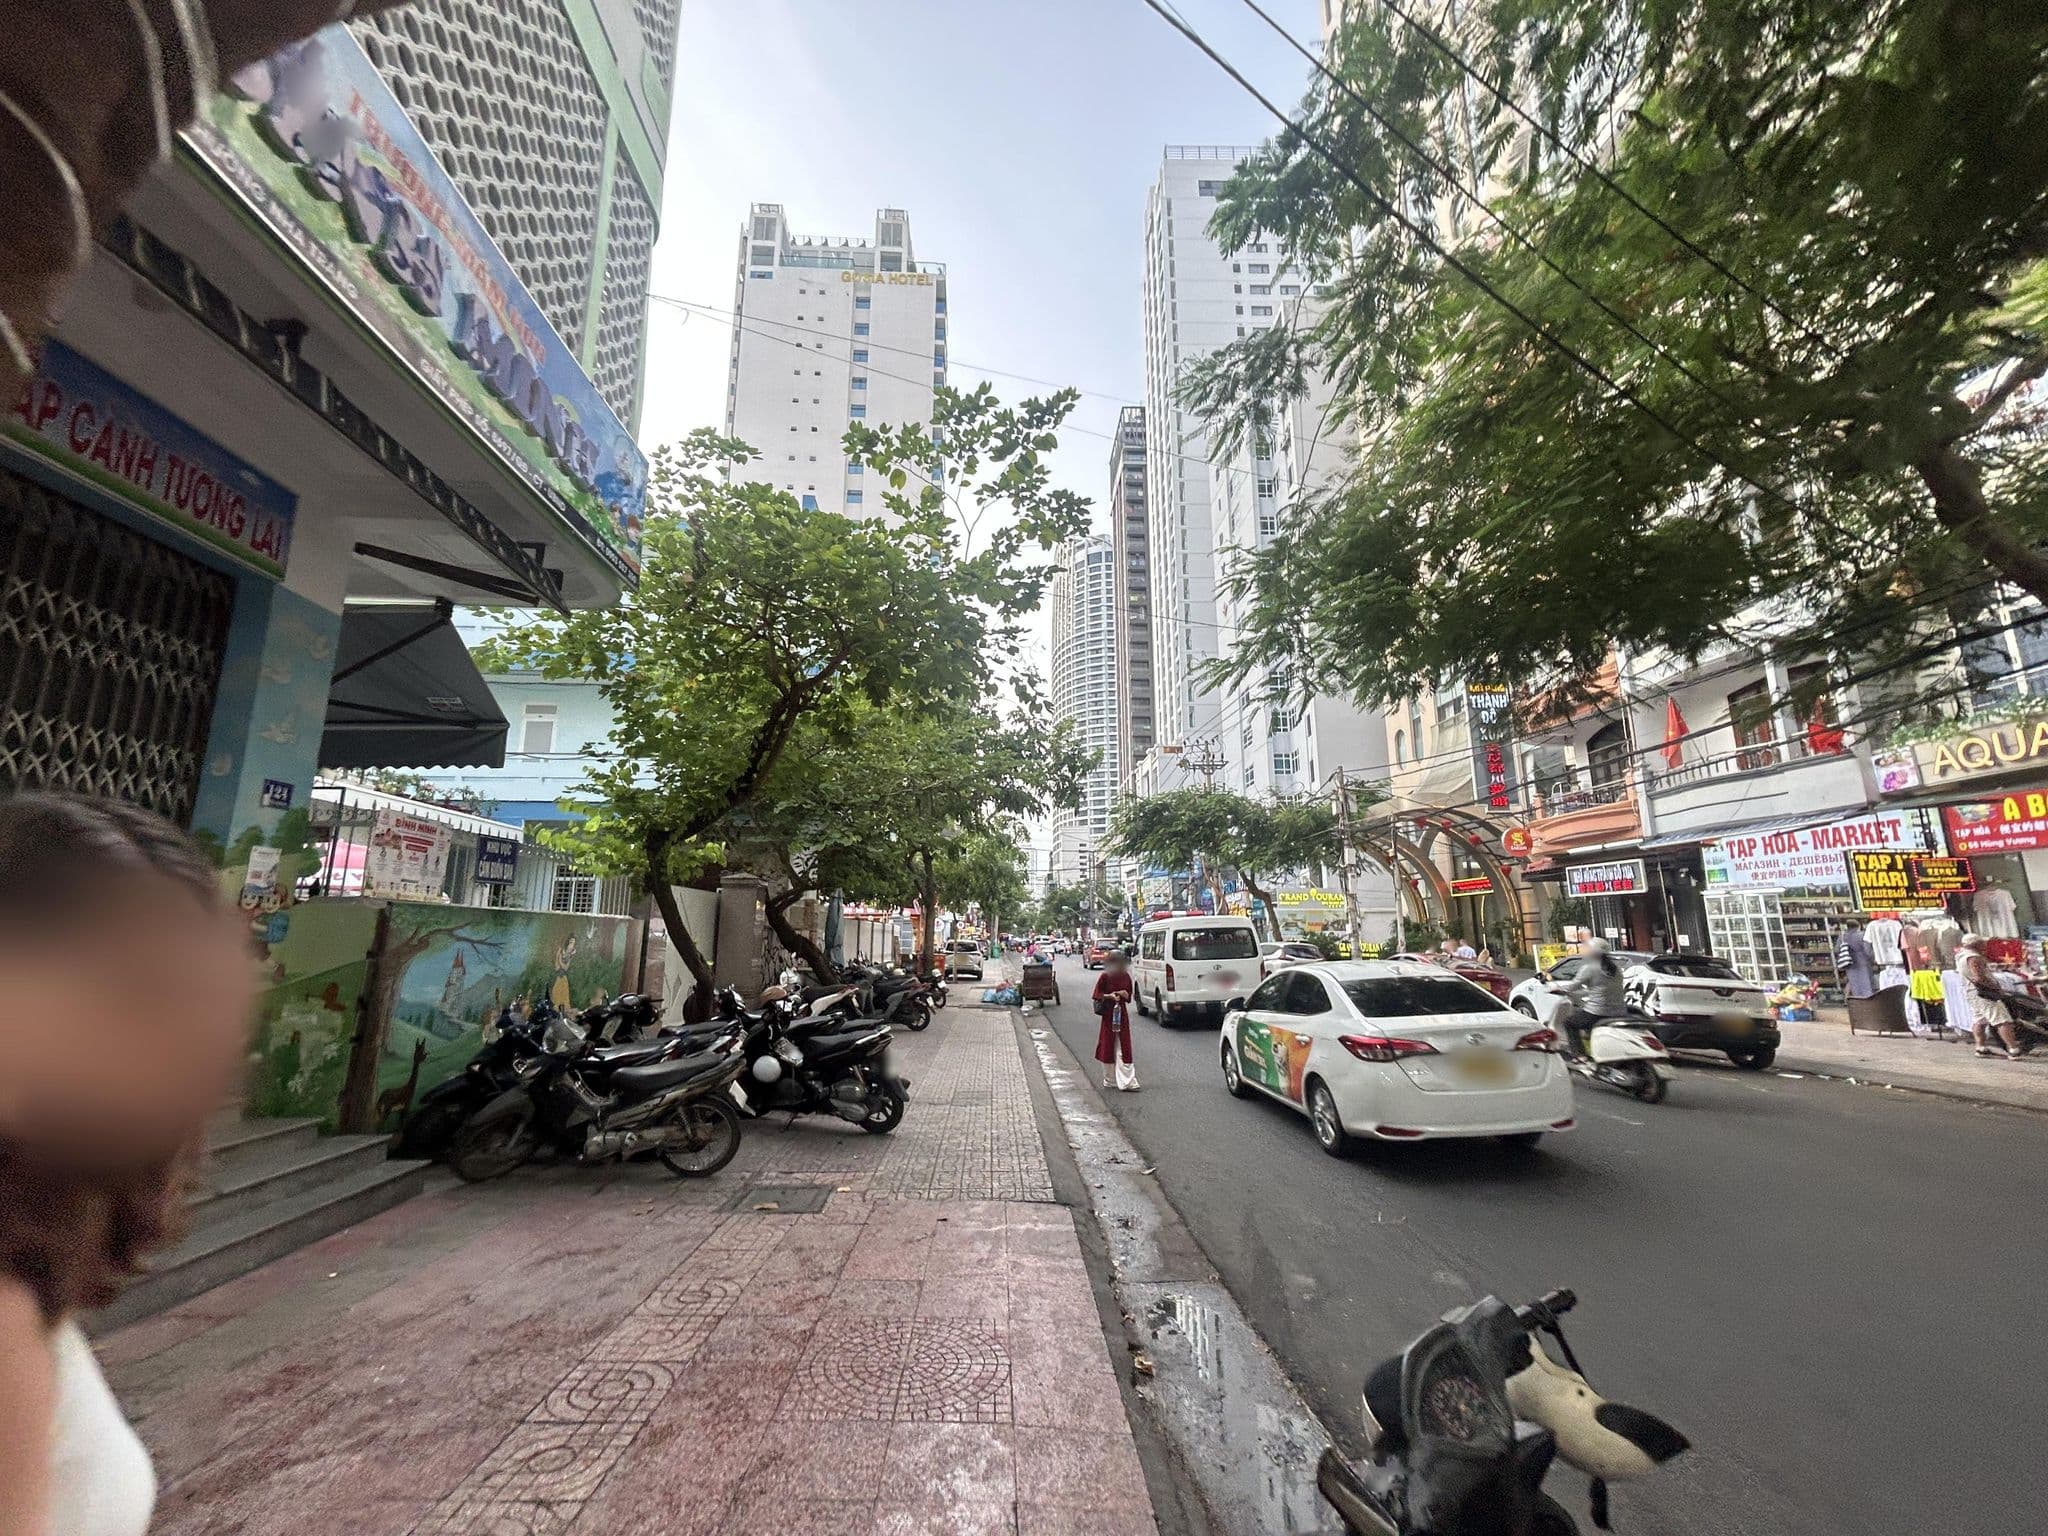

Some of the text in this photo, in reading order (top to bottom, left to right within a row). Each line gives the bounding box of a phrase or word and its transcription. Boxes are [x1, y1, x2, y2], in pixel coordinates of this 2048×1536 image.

[888, 273, 934, 287] HOTEL
[1470, 691, 1508, 709] THÀNH
[2003, 793, 2048, 821] A B
[1726, 837, 1757, 861] TẠP
[1761, 829, 1800, 855] HÓA
[1810, 818, 1902, 850] MARKET
[1855, 854, 1892, 872] TẠP
[1279, 892, 1309, 901] GRAND
